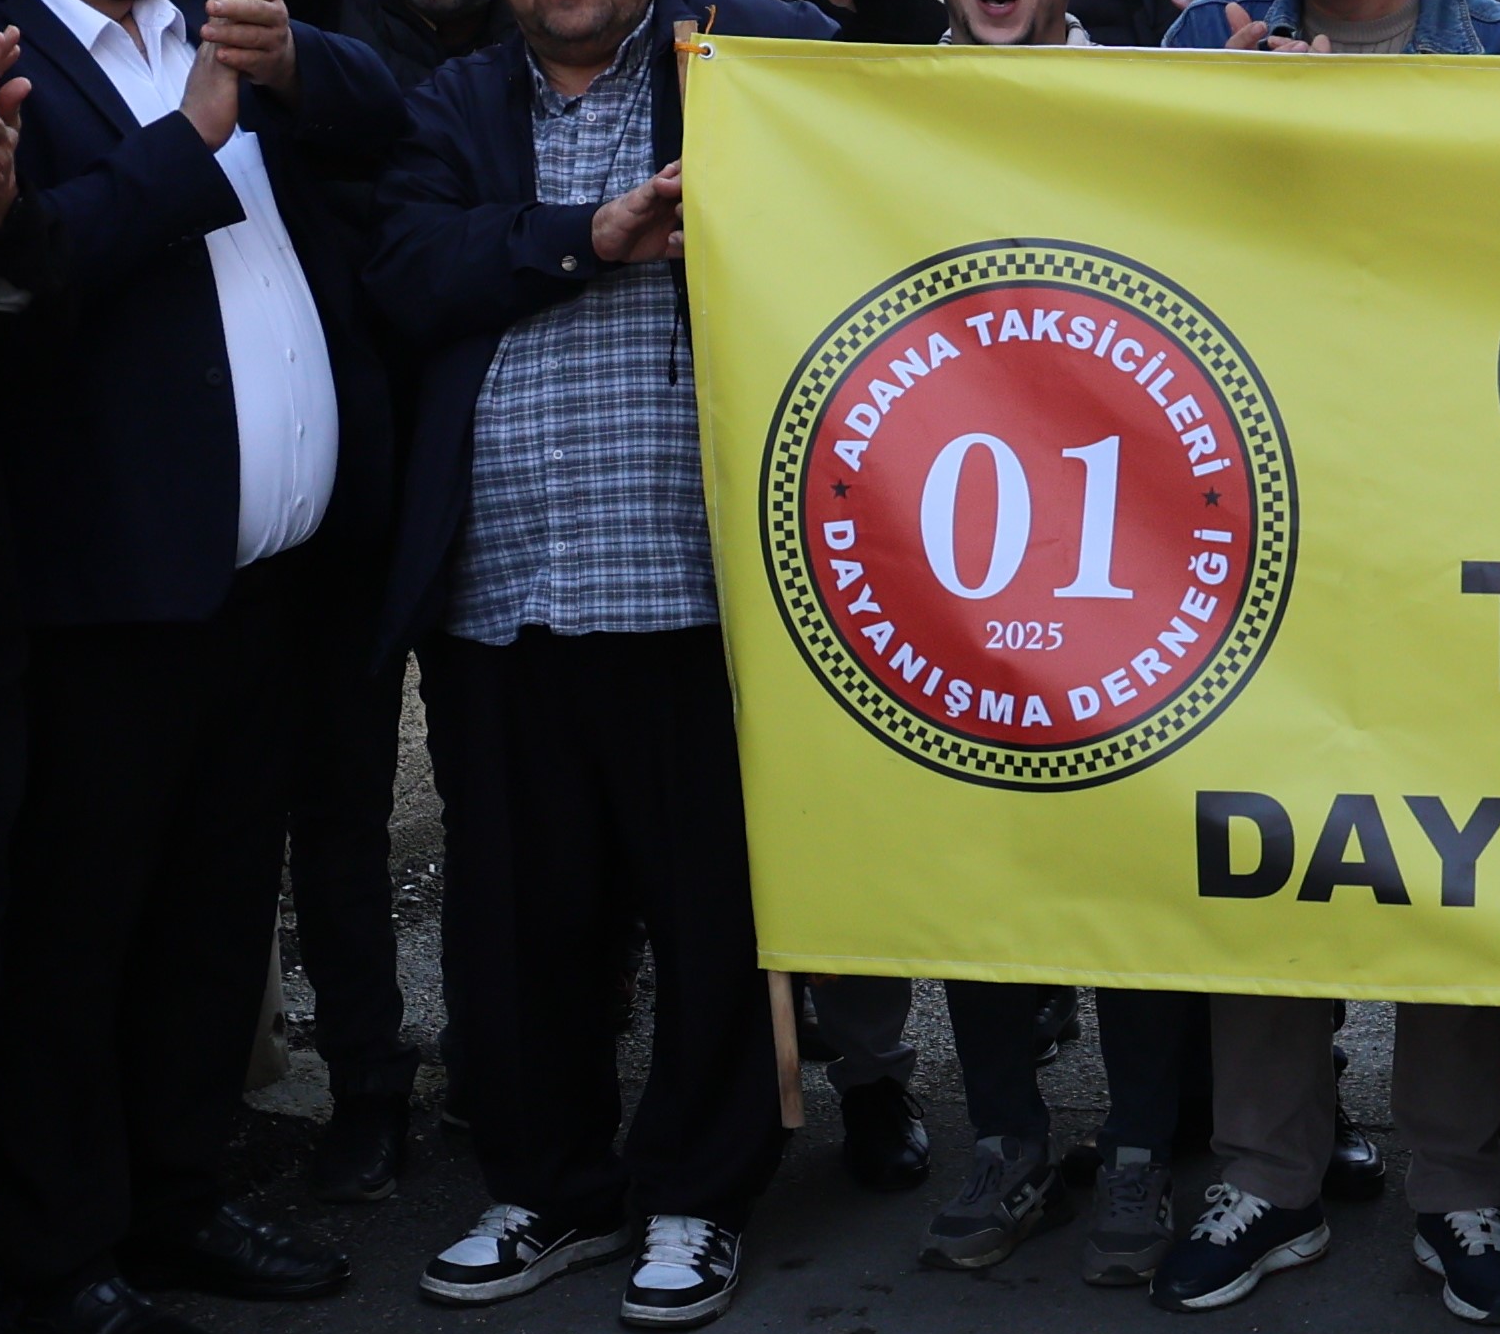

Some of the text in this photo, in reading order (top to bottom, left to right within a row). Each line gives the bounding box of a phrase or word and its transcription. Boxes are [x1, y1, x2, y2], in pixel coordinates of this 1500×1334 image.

[834, 309, 1232, 477] ADANA TAKSİCİLERİ
[921, 432, 1134, 600] 01
[823, 519, 1234, 727] DAYANIŞMA DERNEĞİ
[985, 620, 1064, 651] 2025
